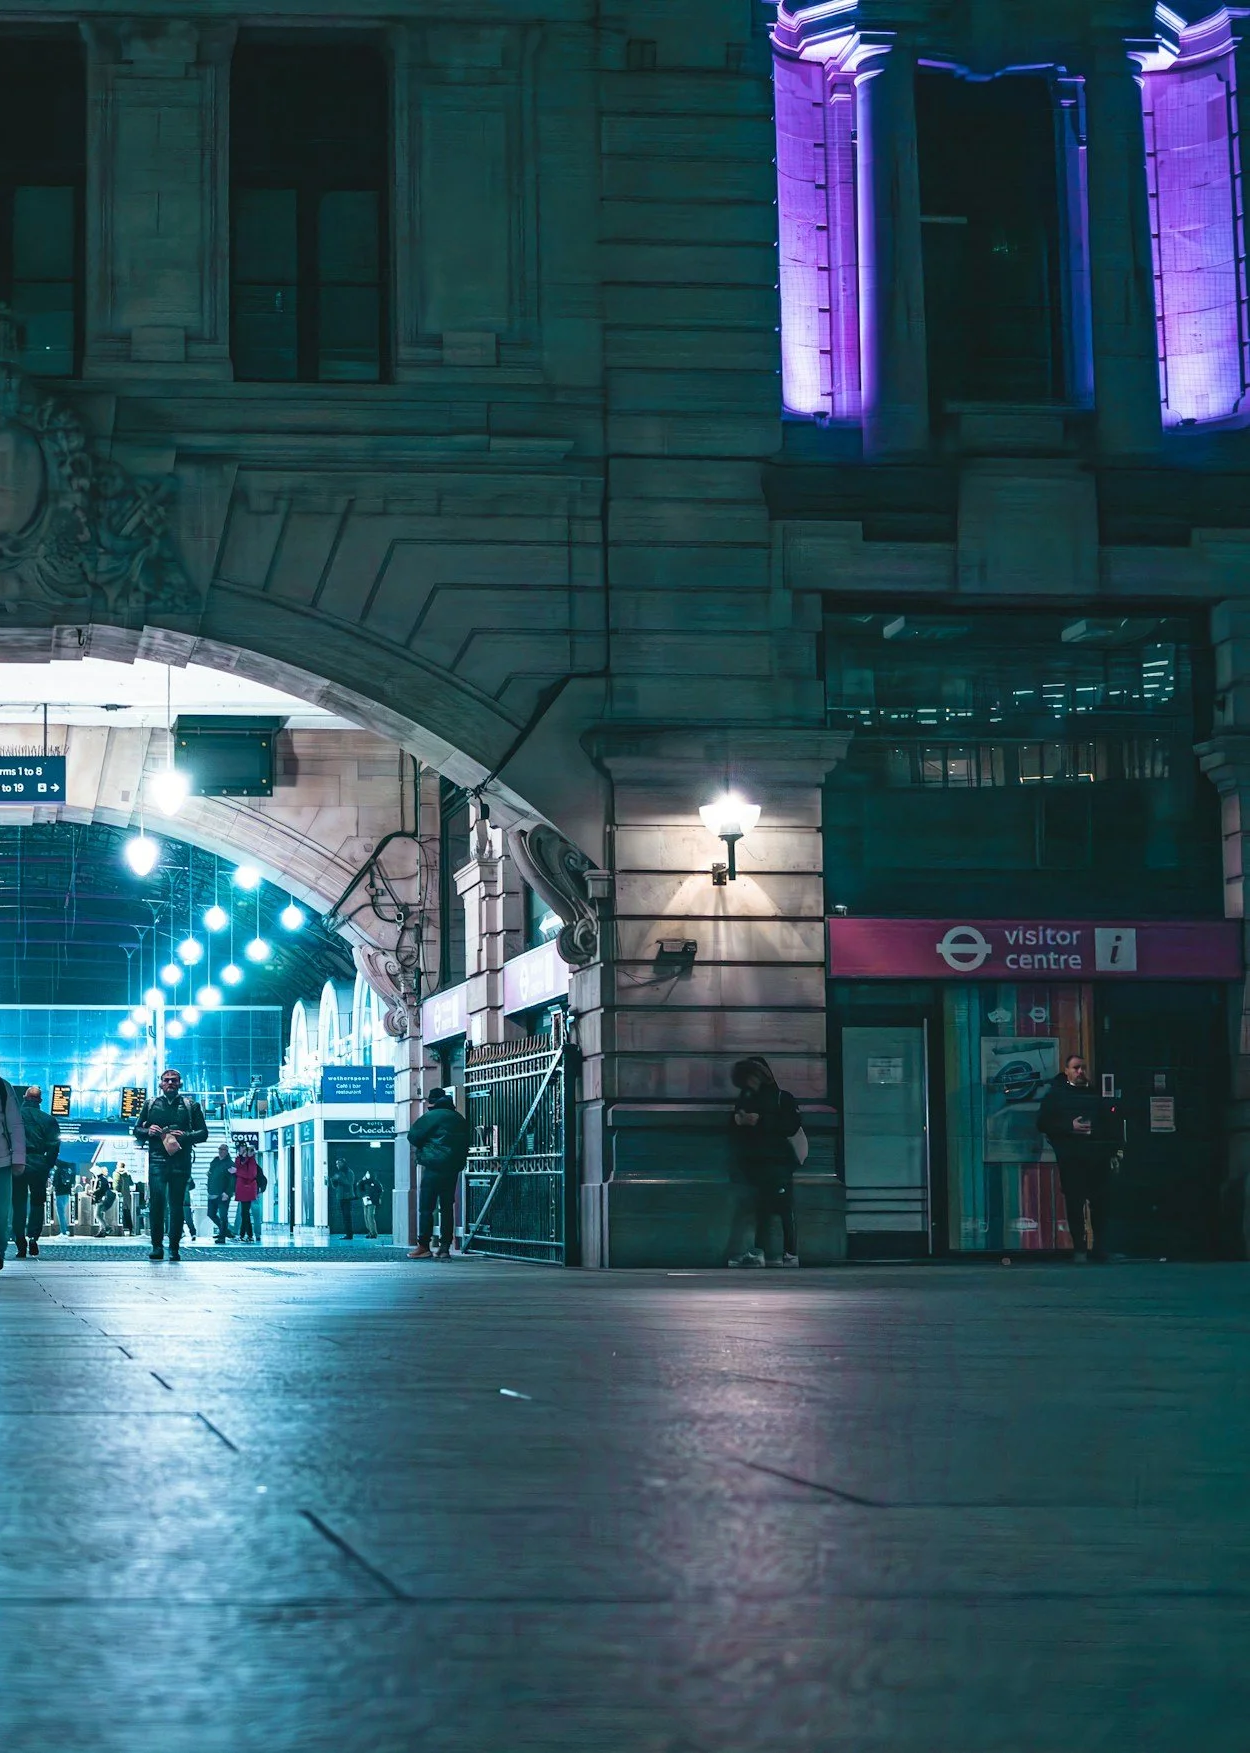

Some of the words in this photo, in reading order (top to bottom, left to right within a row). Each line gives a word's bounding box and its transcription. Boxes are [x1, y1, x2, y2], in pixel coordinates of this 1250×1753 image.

[18, 766, 23, 776] 1
[24, 766, 33, 776] to
[35, 766, 43, 776] 8
[1, 782, 11, 793] to
[13, 783, 24, 793] 19
[1004, 926, 1082, 945] visitor
[1005, 951, 1082, 970] centre
[232, 1133, 259, 1142] COSTA
